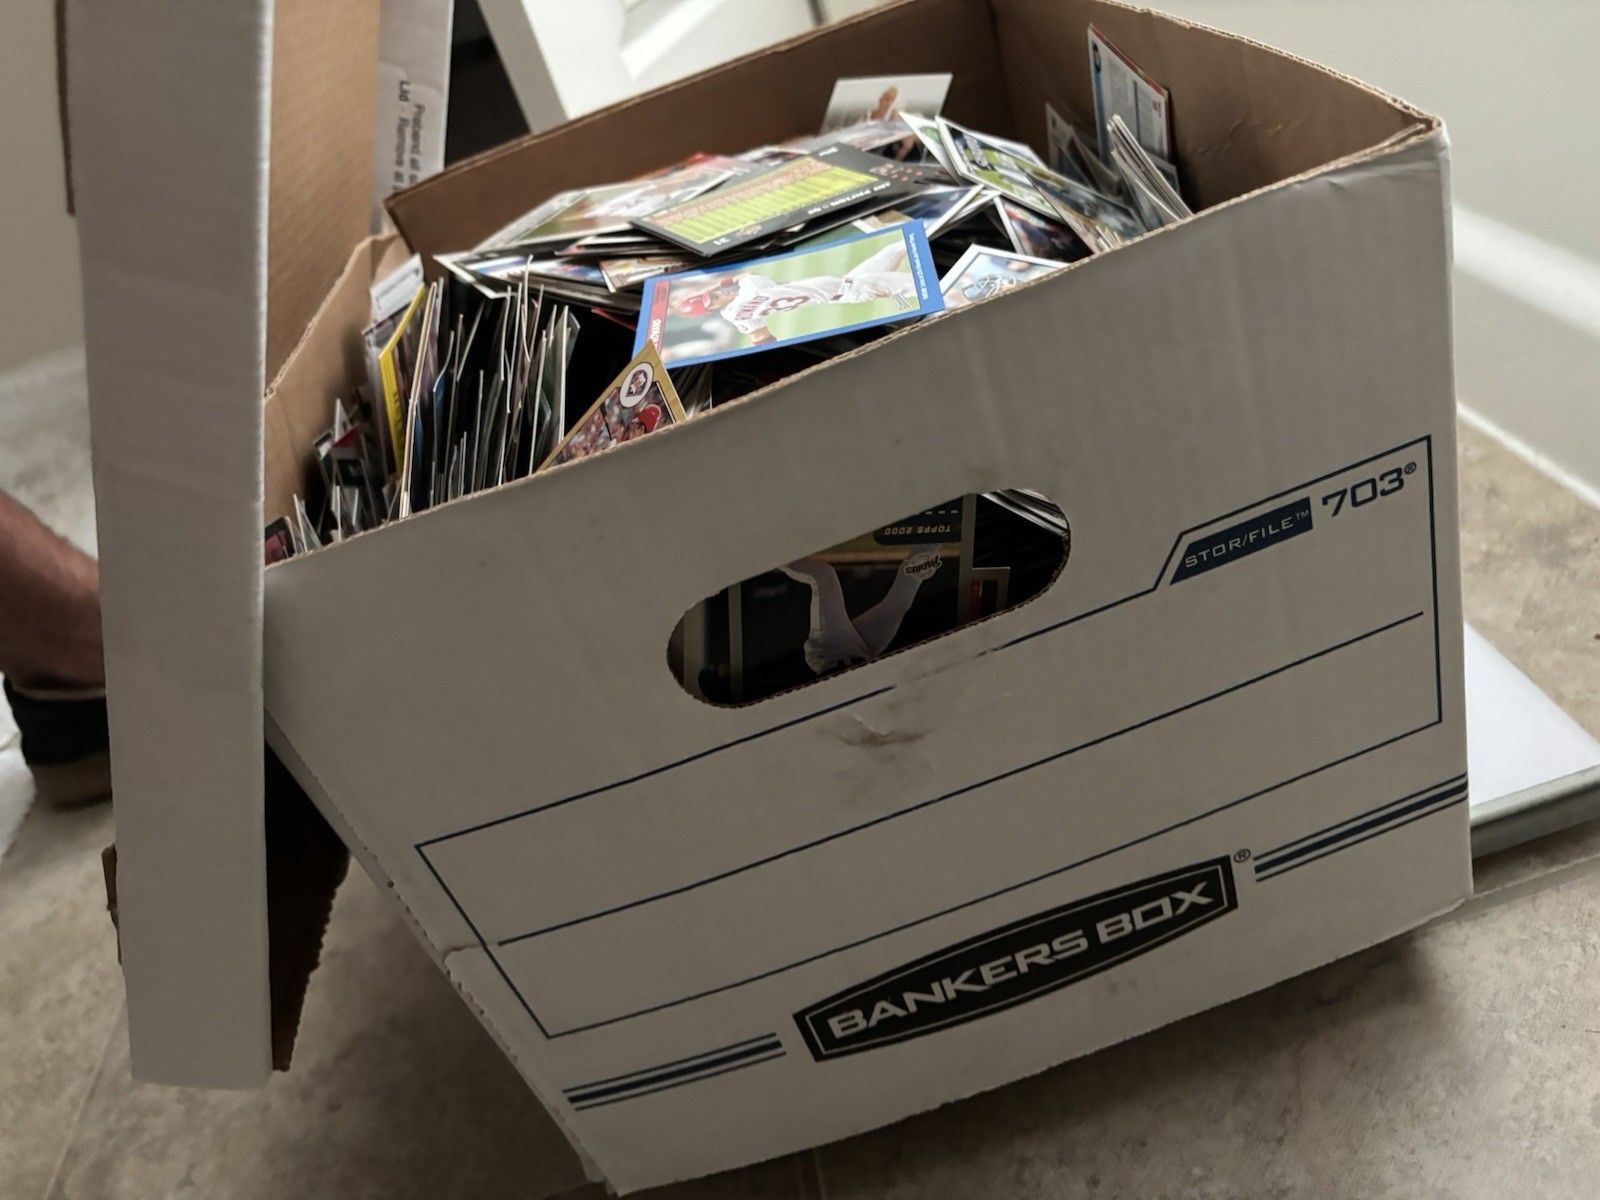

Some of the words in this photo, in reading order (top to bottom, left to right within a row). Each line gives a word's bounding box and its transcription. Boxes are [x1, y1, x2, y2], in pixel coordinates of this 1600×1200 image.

[399, 80, 411, 102] Lid
[884, 525, 913, 536] 2000
[917, 524, 951, 535] TOPPS
[827, 929, 1090, 1040] BANKERS
[1098, 881, 1214, 945] BOX
